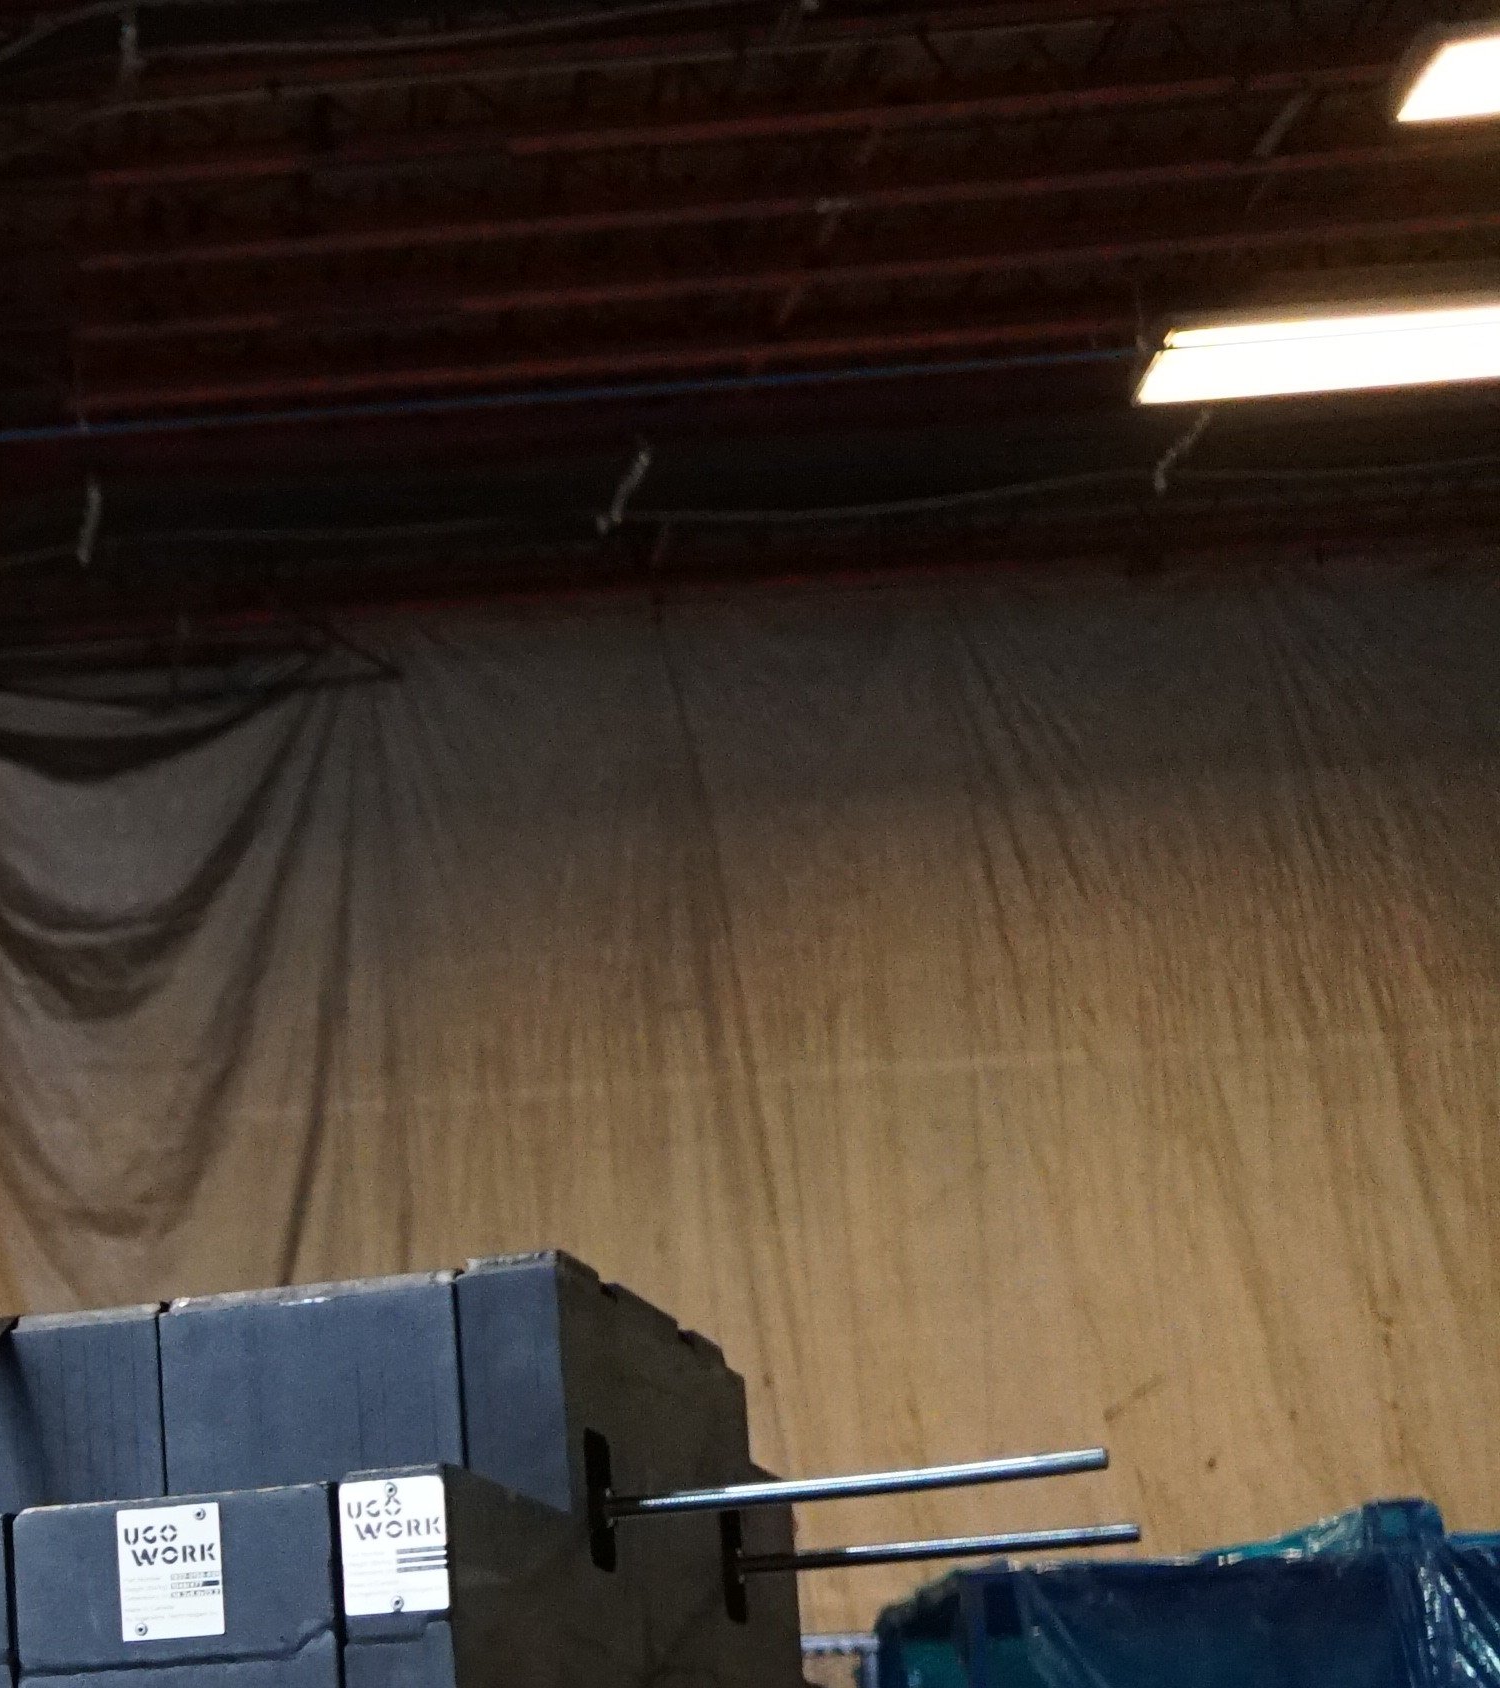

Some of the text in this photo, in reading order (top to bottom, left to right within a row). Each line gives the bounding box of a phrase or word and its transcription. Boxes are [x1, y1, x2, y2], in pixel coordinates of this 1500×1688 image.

[347, 1498, 402, 1519] UGO
[124, 1524, 177, 1545] UGO
[355, 1517, 441, 1541] WORK
[131, 1543, 216, 1567] WORK
